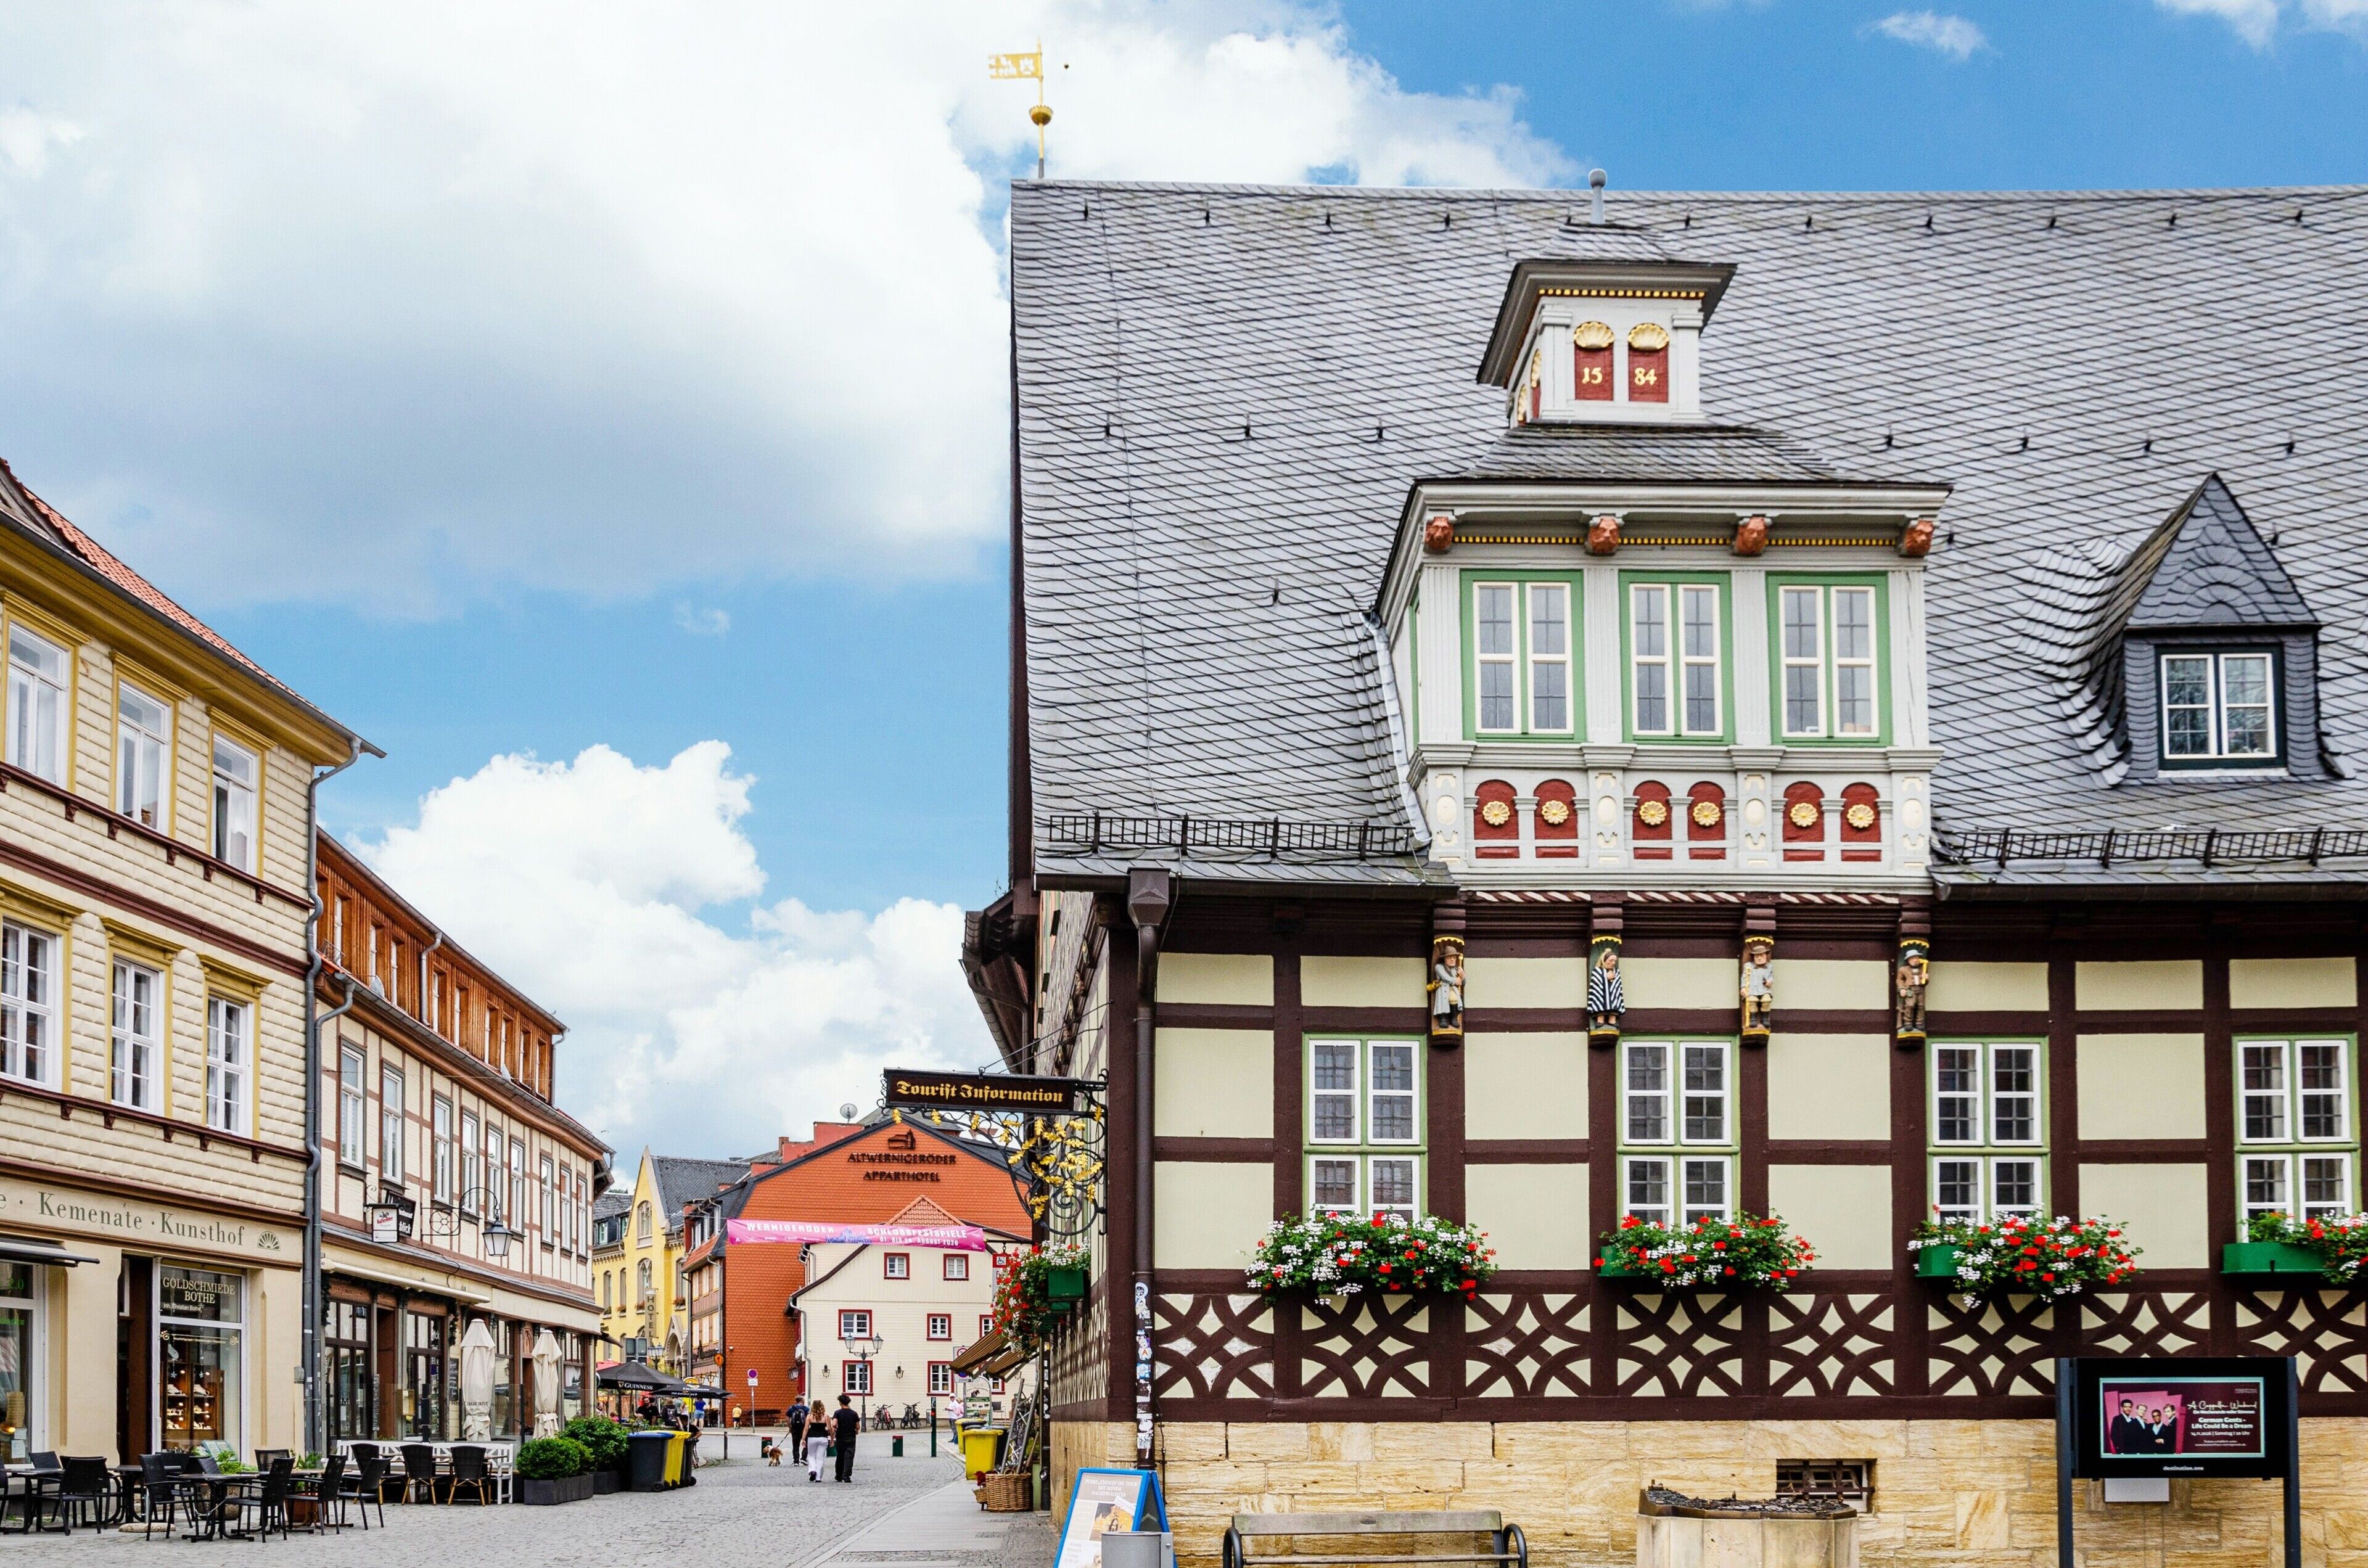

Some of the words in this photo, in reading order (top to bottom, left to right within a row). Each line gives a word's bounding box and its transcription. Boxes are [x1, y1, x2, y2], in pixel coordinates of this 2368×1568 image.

[1582, 367, 1603, 384] 15
[1635, 367, 1658, 386] 84
[897, 1081, 956, 1100] Tourist
[960, 1085, 1063, 1102] Information
[848, 1152, 956, 1164] ALTWERNIGERÖDER
[863, 1171, 940, 1182] APPARTHOTEL
[38, 1191, 142, 1229] Kemenate
[160, 1212, 245, 1246] Kunsthof
[867, 1227, 967, 1238] SCHLOSSFESTSPIELE
[163, 1277, 235, 1294] GOLDSCHMIEDE
[184, 1291, 215, 1303] BOTHE
